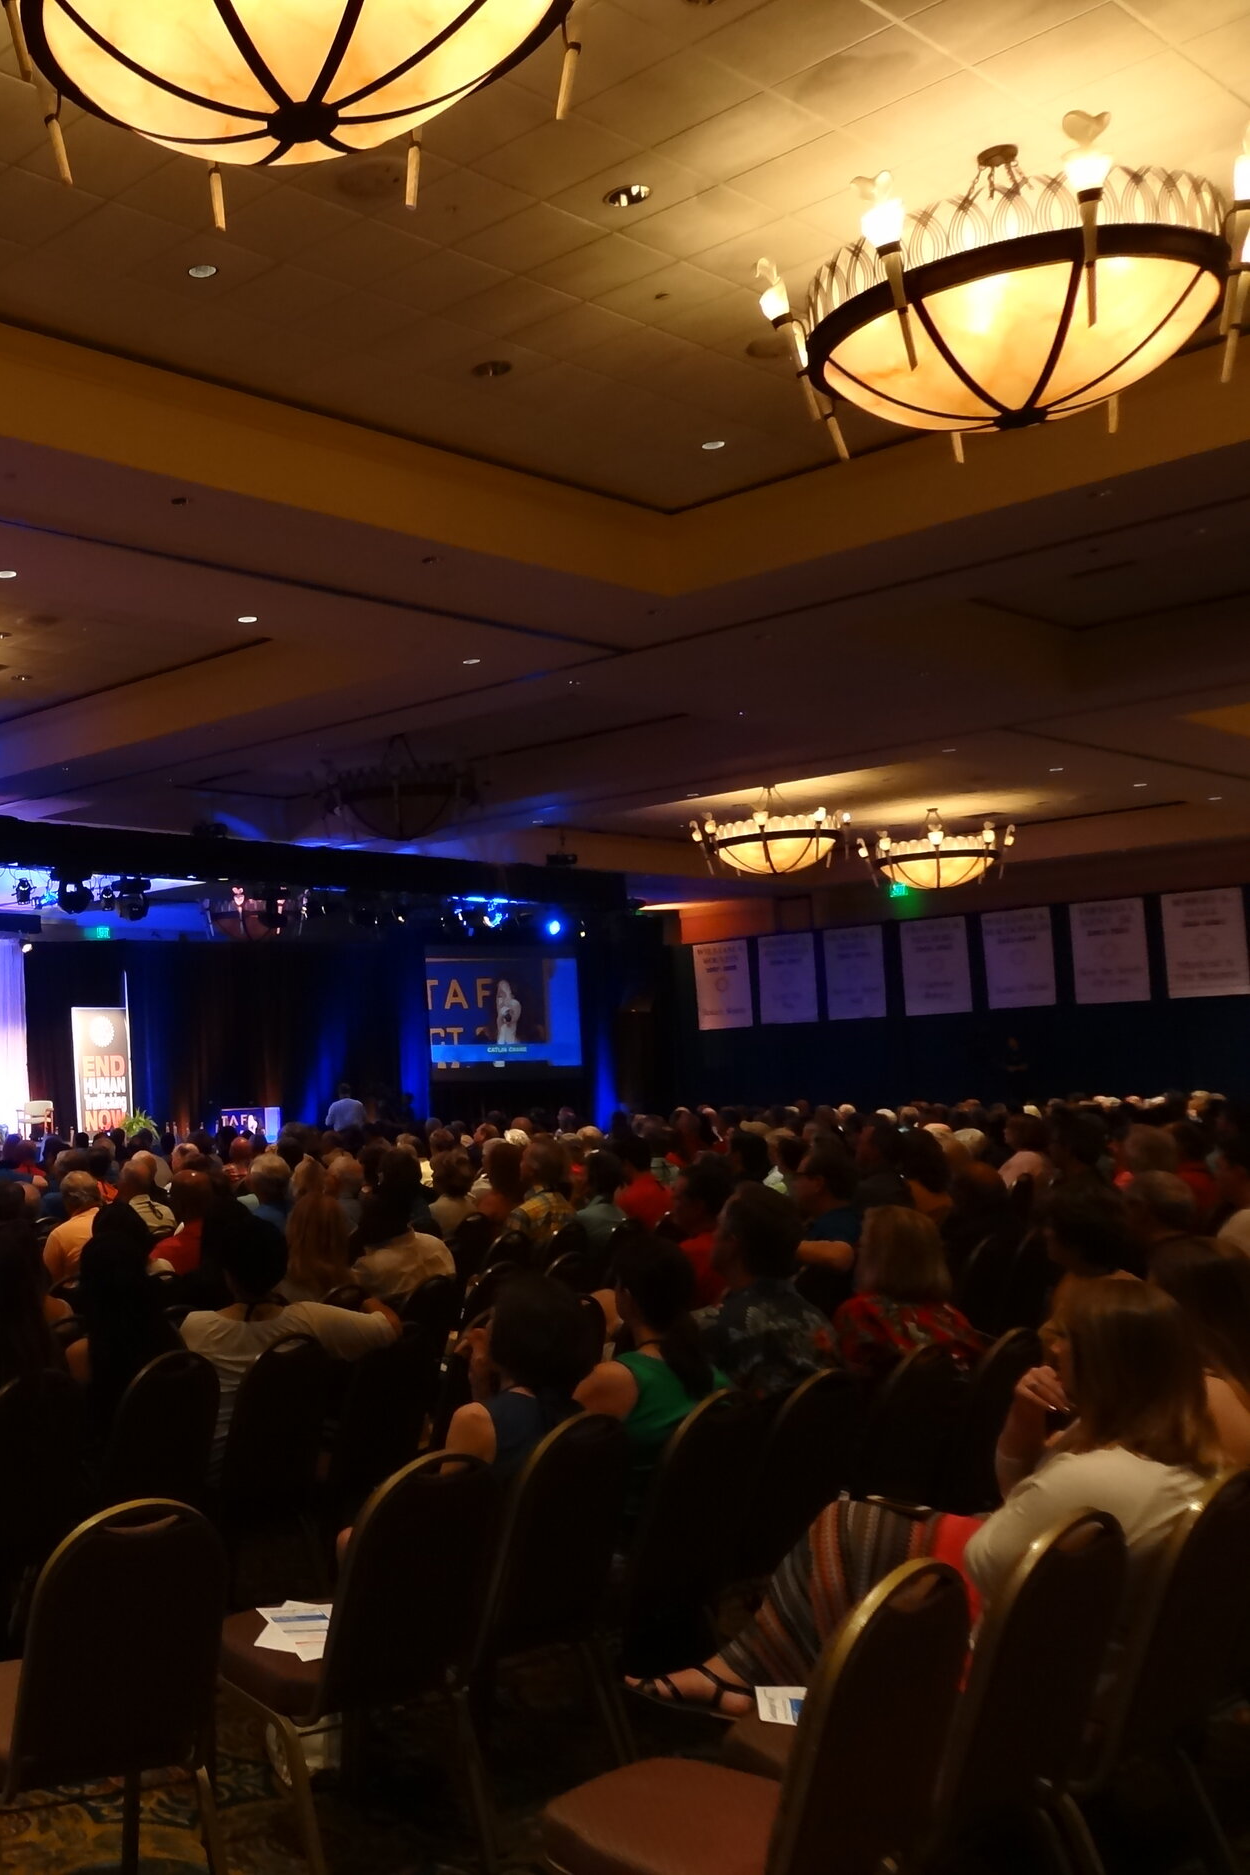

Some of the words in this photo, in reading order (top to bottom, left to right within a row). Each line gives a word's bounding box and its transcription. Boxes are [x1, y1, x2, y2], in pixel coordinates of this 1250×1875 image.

[82, 1055, 125, 1077] END
[83, 1077, 126, 1094] HUMAN
[84, 1110, 126, 1131] NOW
